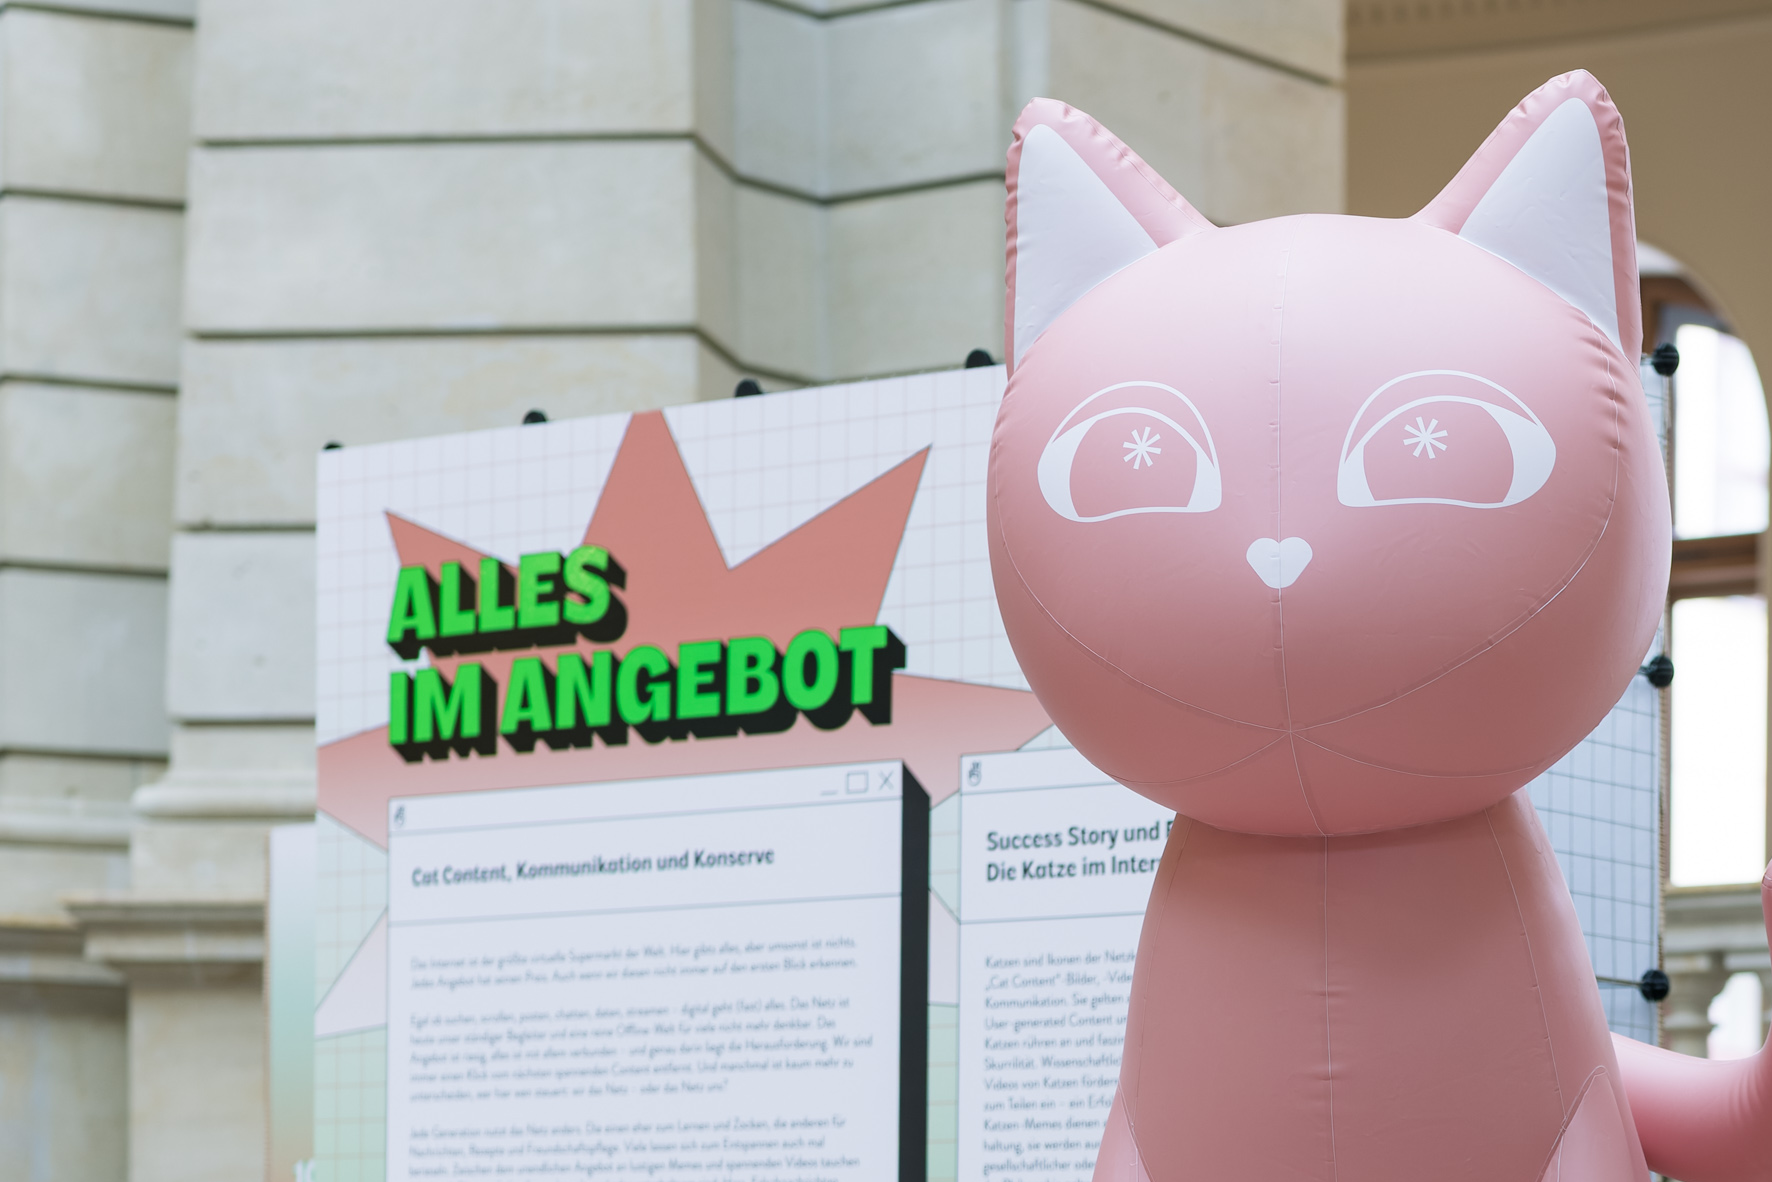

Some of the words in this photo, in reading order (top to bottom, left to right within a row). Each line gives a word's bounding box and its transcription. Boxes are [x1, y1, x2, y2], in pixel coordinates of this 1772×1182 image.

[387, 546, 627, 661] ALLES
[388, 662, 498, 764] IM
[500, 625, 906, 754] ANGEBOT
[986, 830, 1063, 851] Success
[1068, 826, 1119, 850] Story
[1124, 820, 1160, 842] und
[412, 867, 439, 887] Cat
[442, 864, 512, 885] Content,
[516, 854, 652, 881] Kommunikation
[657, 850, 690, 872] und
[694, 848, 775, 869] Konserve
[986, 862, 1017, 882] Die
[1022, 860, 1076, 880] Katze
[1082, 857, 1106, 876] im
[1112, 856, 1161, 875] Inter
